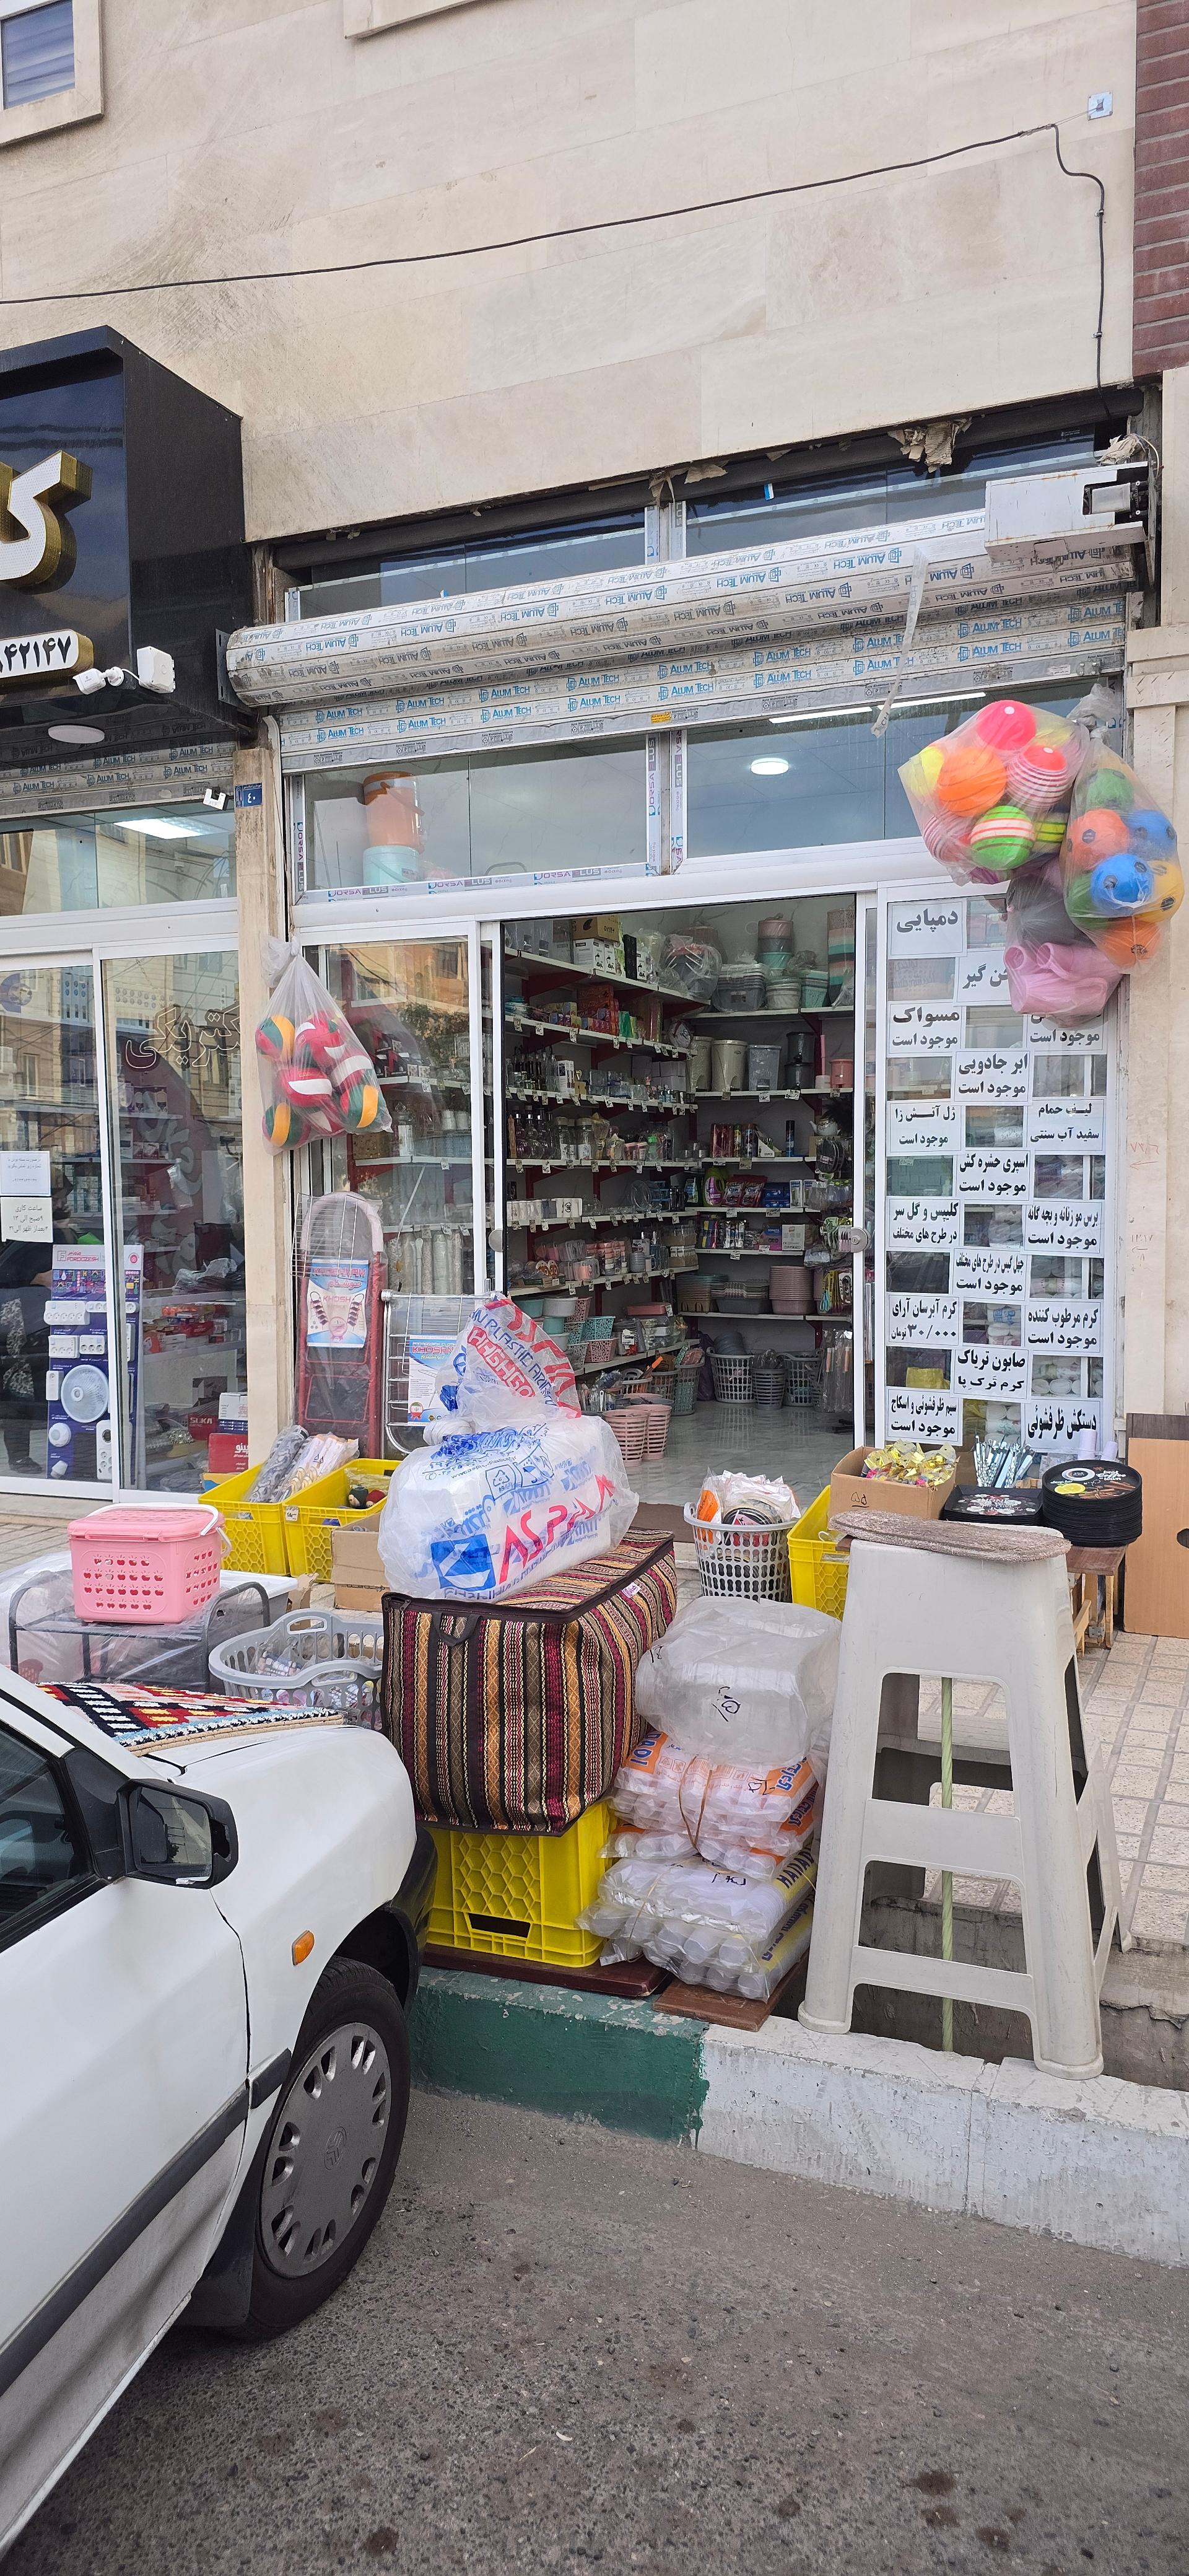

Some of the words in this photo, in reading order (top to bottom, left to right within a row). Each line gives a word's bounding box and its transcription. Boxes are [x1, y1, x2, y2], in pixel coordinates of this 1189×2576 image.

[897, 908, 958, 932] دمپایی
[962, 963, 986, 989] گیر
[893, 1007, 960, 1028] مسواک
[892, 1033, 917, 1046] است
[920, 1036, 957, 1049] موجود
[1030, 1029, 1056, 1042] است
[1060, 1032, 1099, 1046] موجود
[959, 1053, 1007, 1074] جادویی
[1011, 1053, 1027, 1074] ابر
[959, 1081, 983, 1093] است
[988, 1084, 1026, 1097] موجود
[895, 1108, 903, 1122] زا
[1039, 1103, 1063, 1117] حمام
[899, 1133, 917, 1144] است
[1030, 1131, 1054, 1142] سنتی
[1058, 1127, 1074, 1139] آب
[1077, 1129, 1099, 1141] سفید
[920, 1136, 947, 1147] موجود
[960, 1154, 976, 1172] کش
[978, 1158, 1000, 1173] حشره
[1003, 1154, 1028, 1173] اسپری
[959, 1180, 984, 1191] است
[988, 1182, 1026, 1196] موجود
[894, 1209, 904, 1220] سر
[907, 1202, 920, 1220] گل
[923, 1209, 927, 1220] و
[931, 1202, 959, 1222] کلیپس
[1028, 1205, 1040, 1220] گانه
[1042, 1209, 1052, 1226] بچه
[1060, 1207, 1073, 1226] زنانه
[1074, 1213, 1082, 1227] مو
[1084, 1212, 1098, 1227] برس
[893, 1227, 913, 1238] مختلف
[916, 1227, 929, 1243] های
[931, 1228, 946, 1243] طرح
[949, 1231, 957, 1243] در
[1028, 1232, 1053, 1243] است
[1058, 1235, 1097, 1250] موجود
[956, 1253, 970, 1267] مختلف
[972, 1254, 981, 1272] های
[983, 1254, 993, 1273] طرح
[994, 1258, 1000, 1273] در
[1013, 1255, 1024, 1275] چهل
[957, 1277, 981, 1289] است
[985, 1281, 1022, 1295] موجود
[913, 1299, 940, 1318] آبرسان
[943, 1301, 957, 1319] کرم
[1029, 1307, 1049, 1322] کننده
[1052, 1308, 1080, 1323] مرطوب
[1083, 1308, 1098, 1328] کرم
[892, 1327, 906, 1340] تومان
[1028, 1331, 1053, 1343] است
[1058, 1334, 1097, 1349] موجود
[958, 1349, 989, 1370] تریاک
[993, 1352, 1025, 1372] صابون
[958, 1376, 966, 1388] پا
[1001, 1381, 1024, 1391] کرم
[911, 1402, 913, 1414] و
[946, 1405, 956, 1416] سیم
[891, 1420, 915, 1431] است
[919, 1423, 955, 1437] موجود
[1067, 1409, 1097, 1440] دستکش
